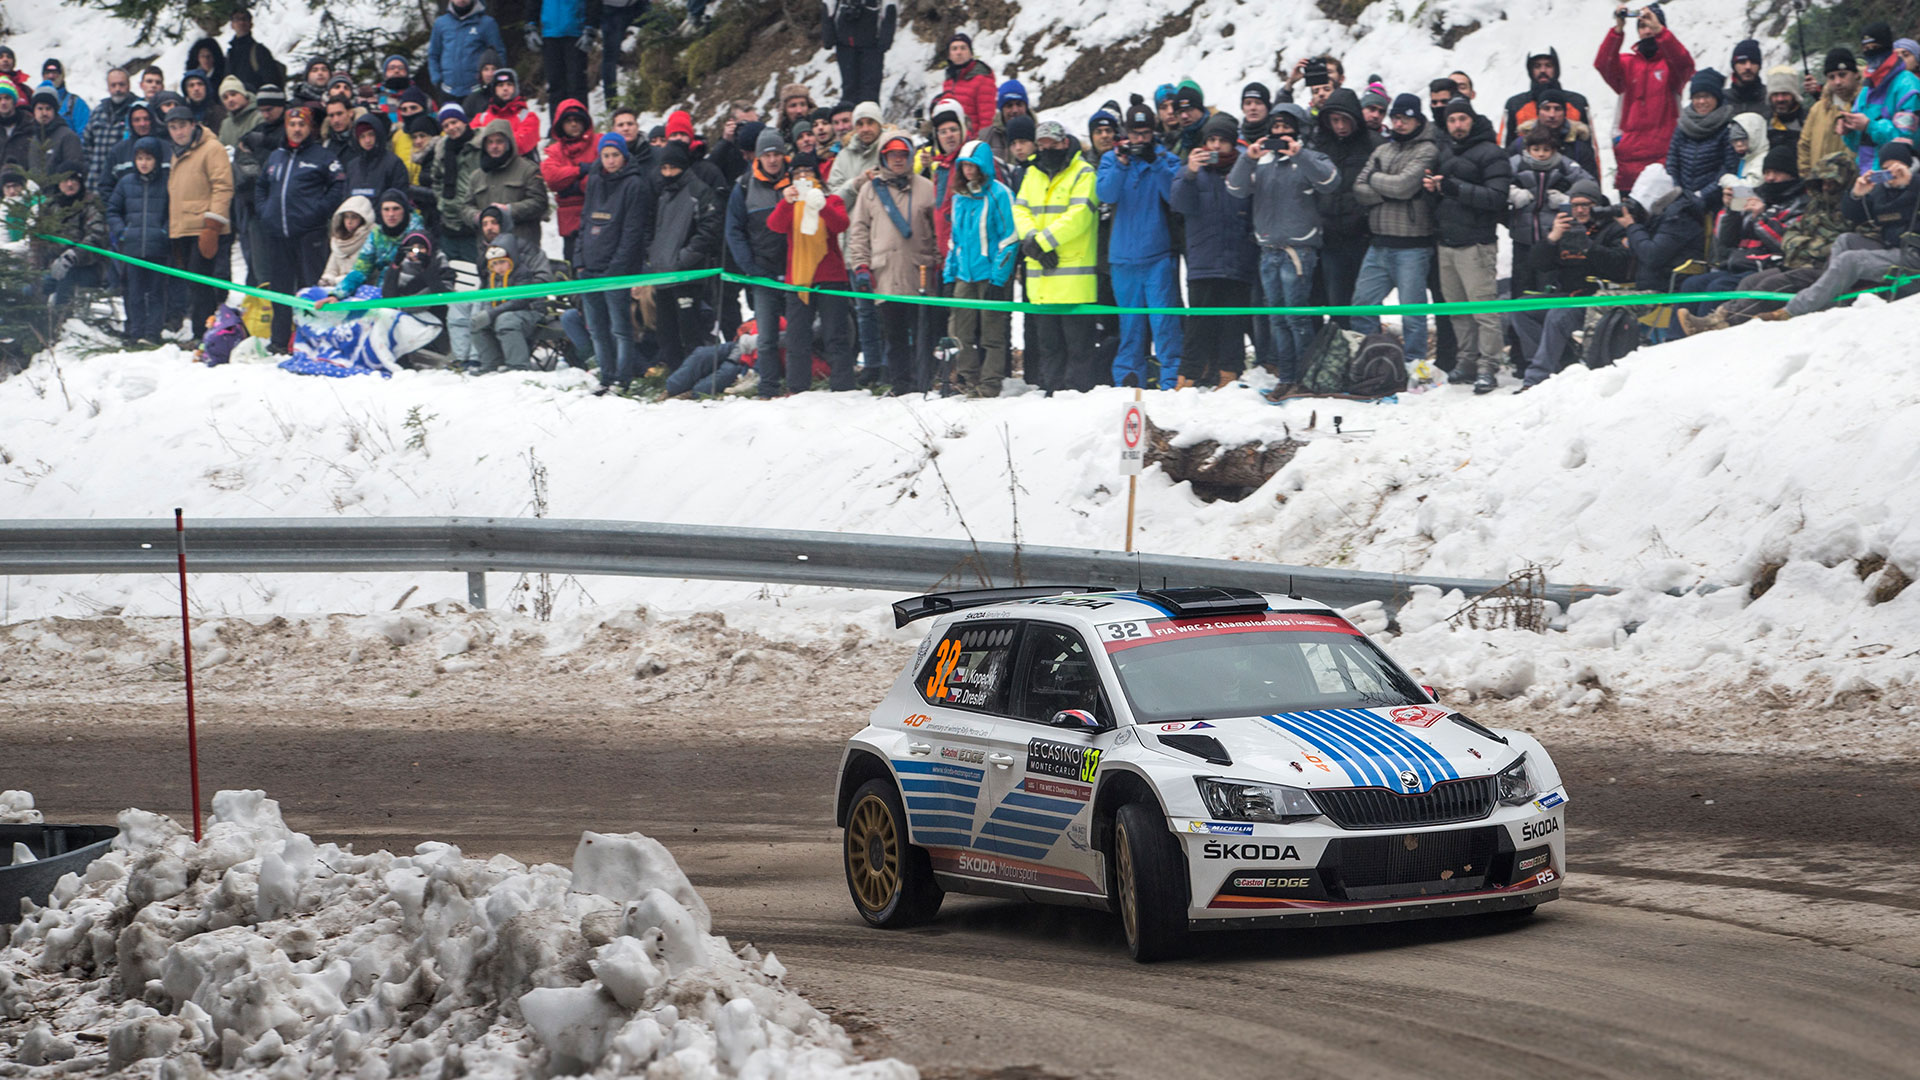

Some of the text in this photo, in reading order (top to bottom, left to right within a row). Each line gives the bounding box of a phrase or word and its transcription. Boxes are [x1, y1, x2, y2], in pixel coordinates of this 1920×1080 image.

[1108, 622, 1142, 639] 32
[1155, 627, 1176, 636] FIA
[1176, 624, 1203, 633] WRC
[1214, 618, 1290, 629] Championship
[926, 638, 962, 698] 32
[962, 689, 987, 706] Dresler
[958, 748, 985, 764] EDGE
[1040, 743, 1080, 764] CASINO
[1082, 748, 1100, 783] 32
[1211, 824, 1253, 832] MICHELIN
[1522, 816, 1559, 841] ŠKODA
[1203, 840, 1301, 861] ŠKODA
[959, 853, 1038, 881] ŠKODA Motorsport
[1241, 878, 1311, 888] Castrol EDGE
[1536, 869, 1554, 885] R5
